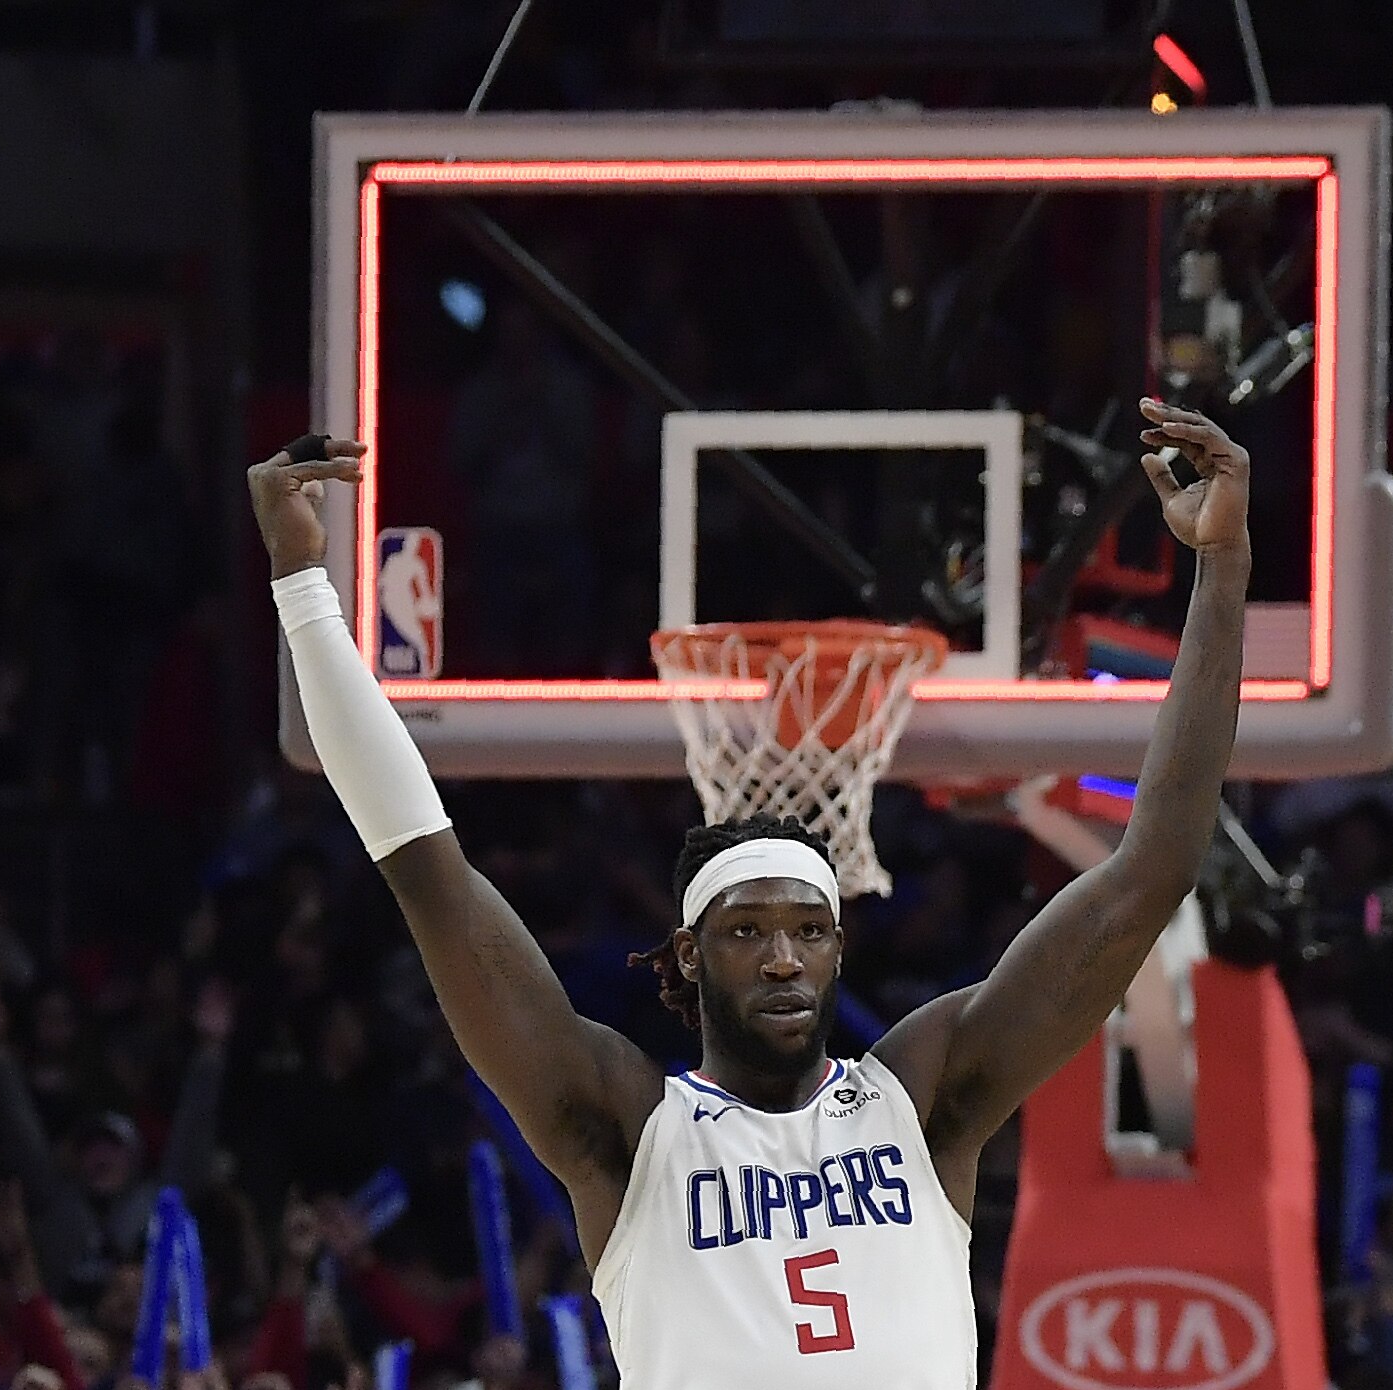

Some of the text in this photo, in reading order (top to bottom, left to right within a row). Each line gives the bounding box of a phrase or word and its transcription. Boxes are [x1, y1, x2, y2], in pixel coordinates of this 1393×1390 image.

[687, 1143, 912, 1250] CLIPPERS
[783, 1248, 855, 1354] 5
[1064, 1299, 1232, 1374] KIA
